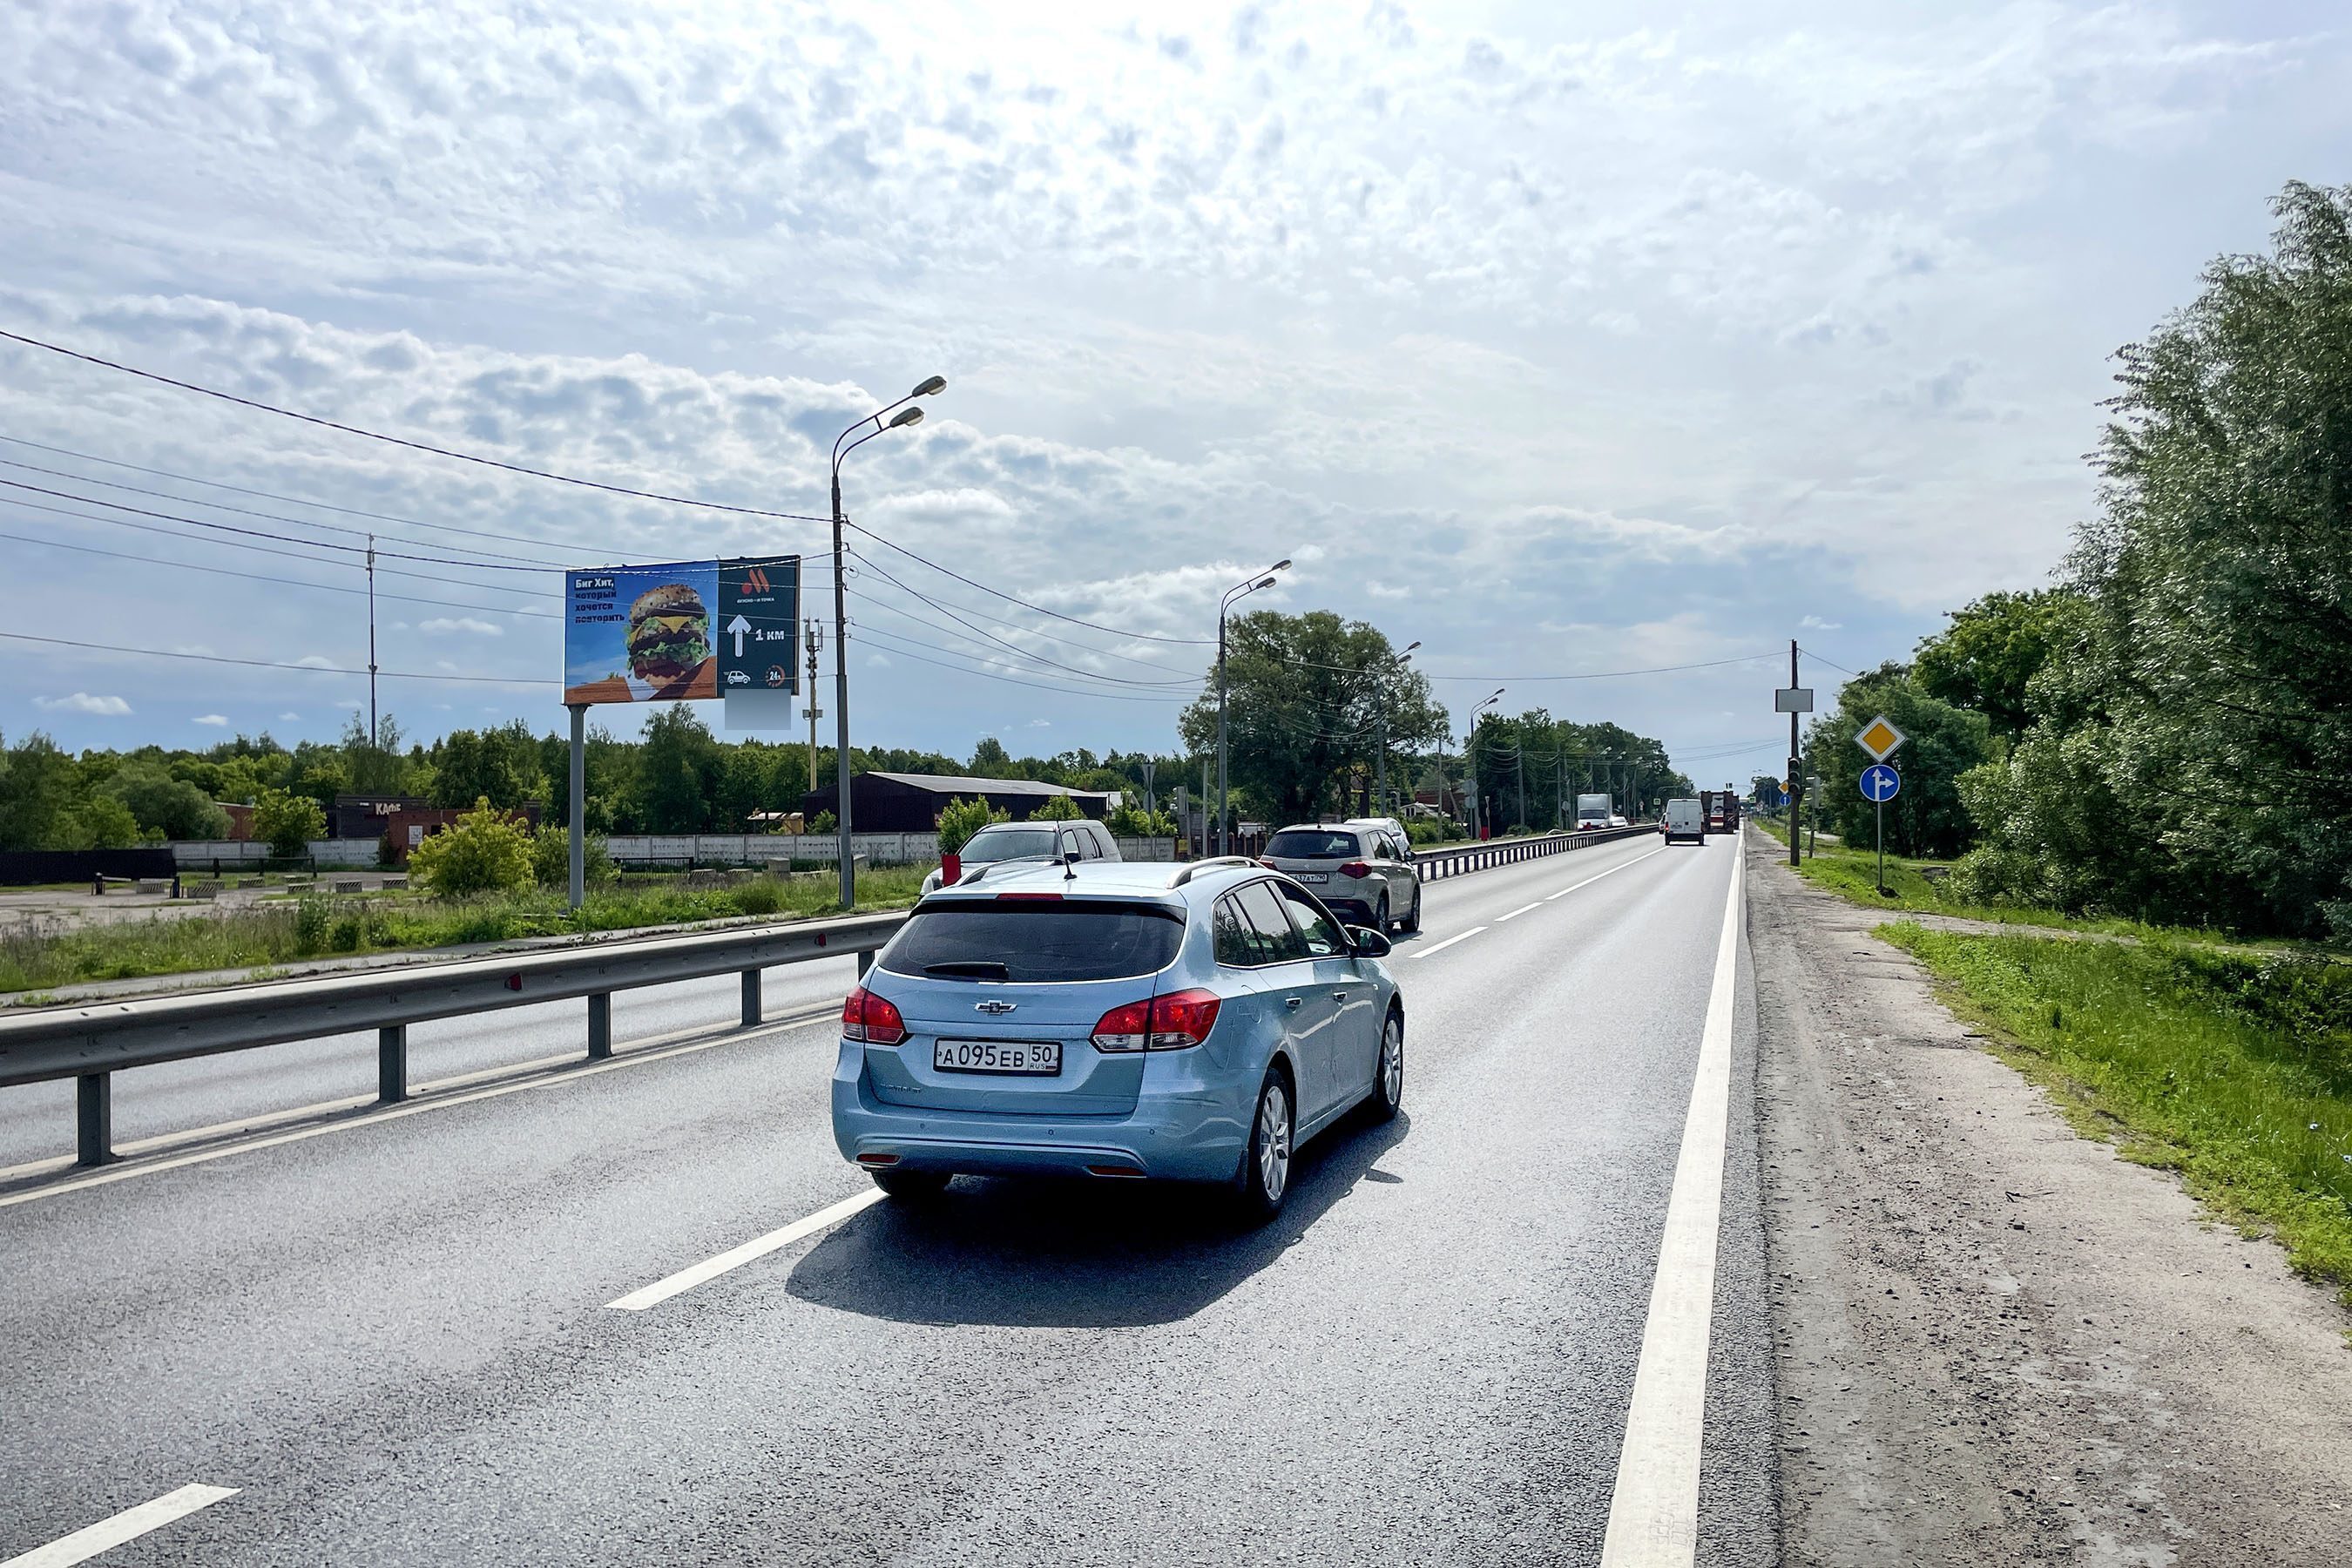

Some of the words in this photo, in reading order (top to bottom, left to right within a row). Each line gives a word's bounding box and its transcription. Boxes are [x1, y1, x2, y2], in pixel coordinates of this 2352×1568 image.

[575, 578, 593, 589] Биг
[594, 578, 614, 588] Хит,
[575, 603, 613, 612] хочется
[575, 614, 625, 624] повторить
[755, 628, 764, 641] 1
[1031, 1045, 1052, 1063] 50
